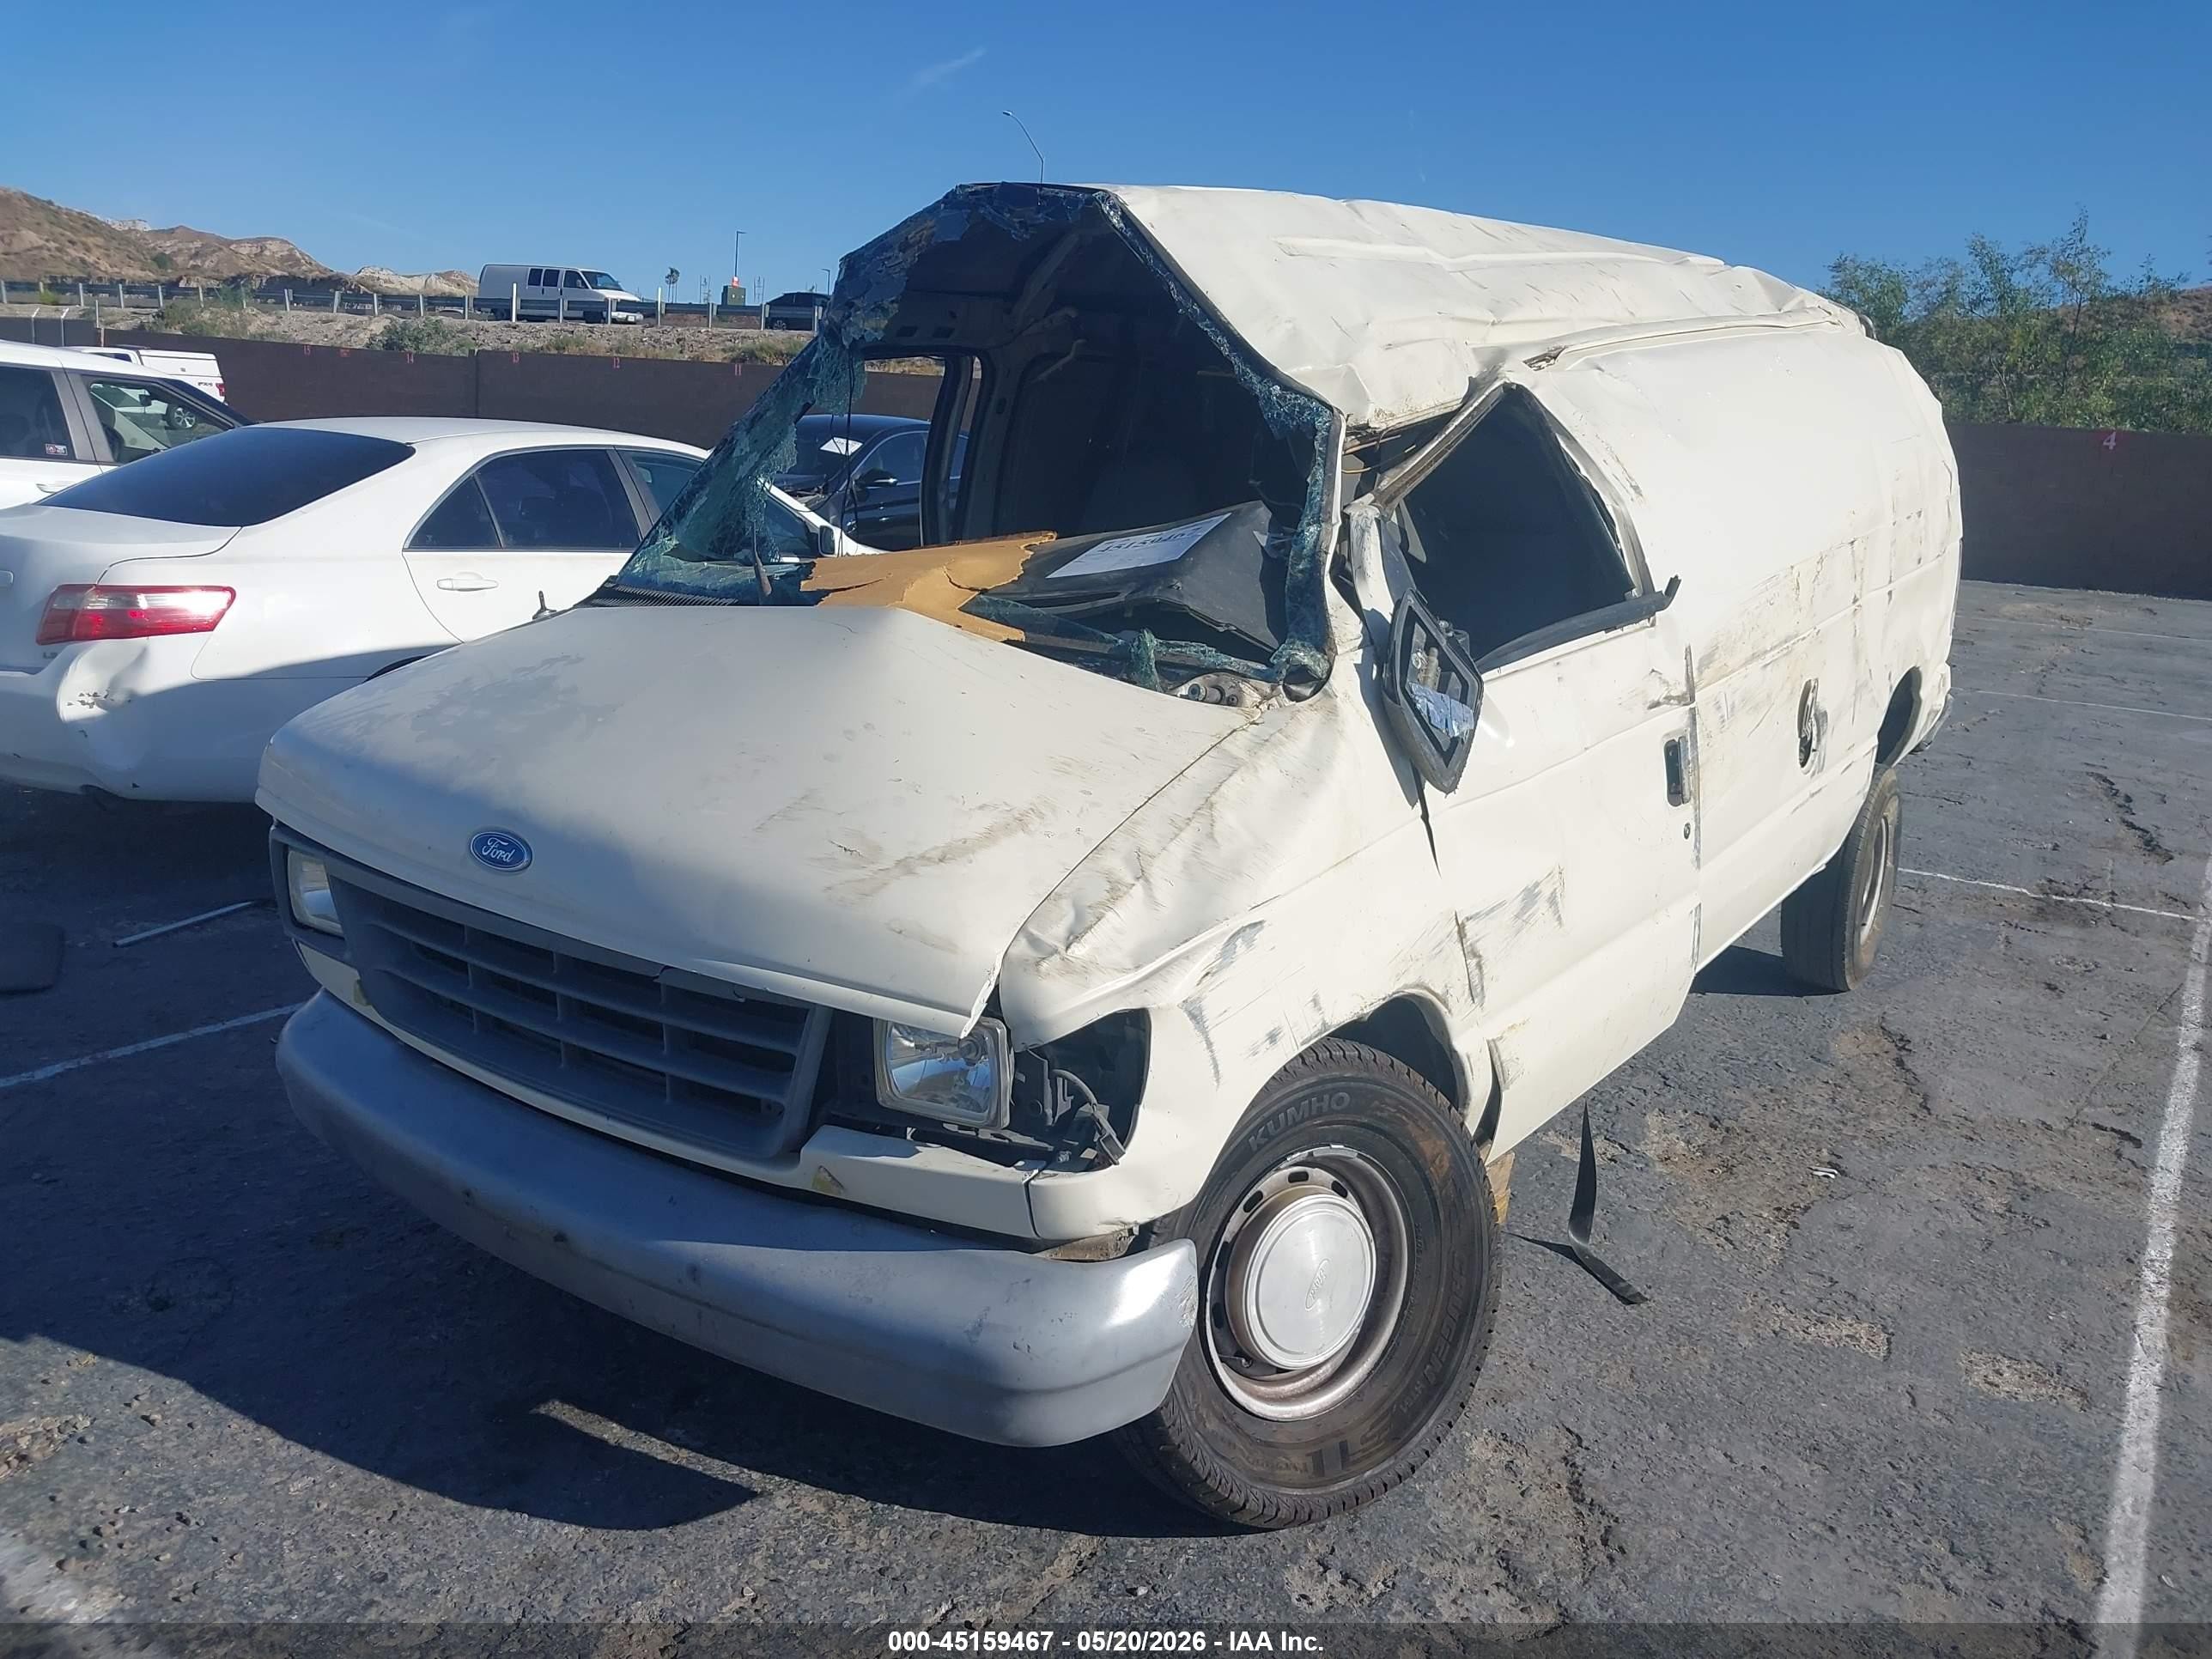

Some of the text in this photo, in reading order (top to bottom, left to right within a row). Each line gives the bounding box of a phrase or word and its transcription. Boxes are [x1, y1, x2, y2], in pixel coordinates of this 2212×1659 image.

[407, 352, 414, 364] 14
[613, 356, 620, 368] 12
[734, 363, 742, 376] 11
[2102, 431, 2117, 450] 4
[482, 836, 516, 862] Ford
[1249, 1091, 1351, 1152] KUMHO
